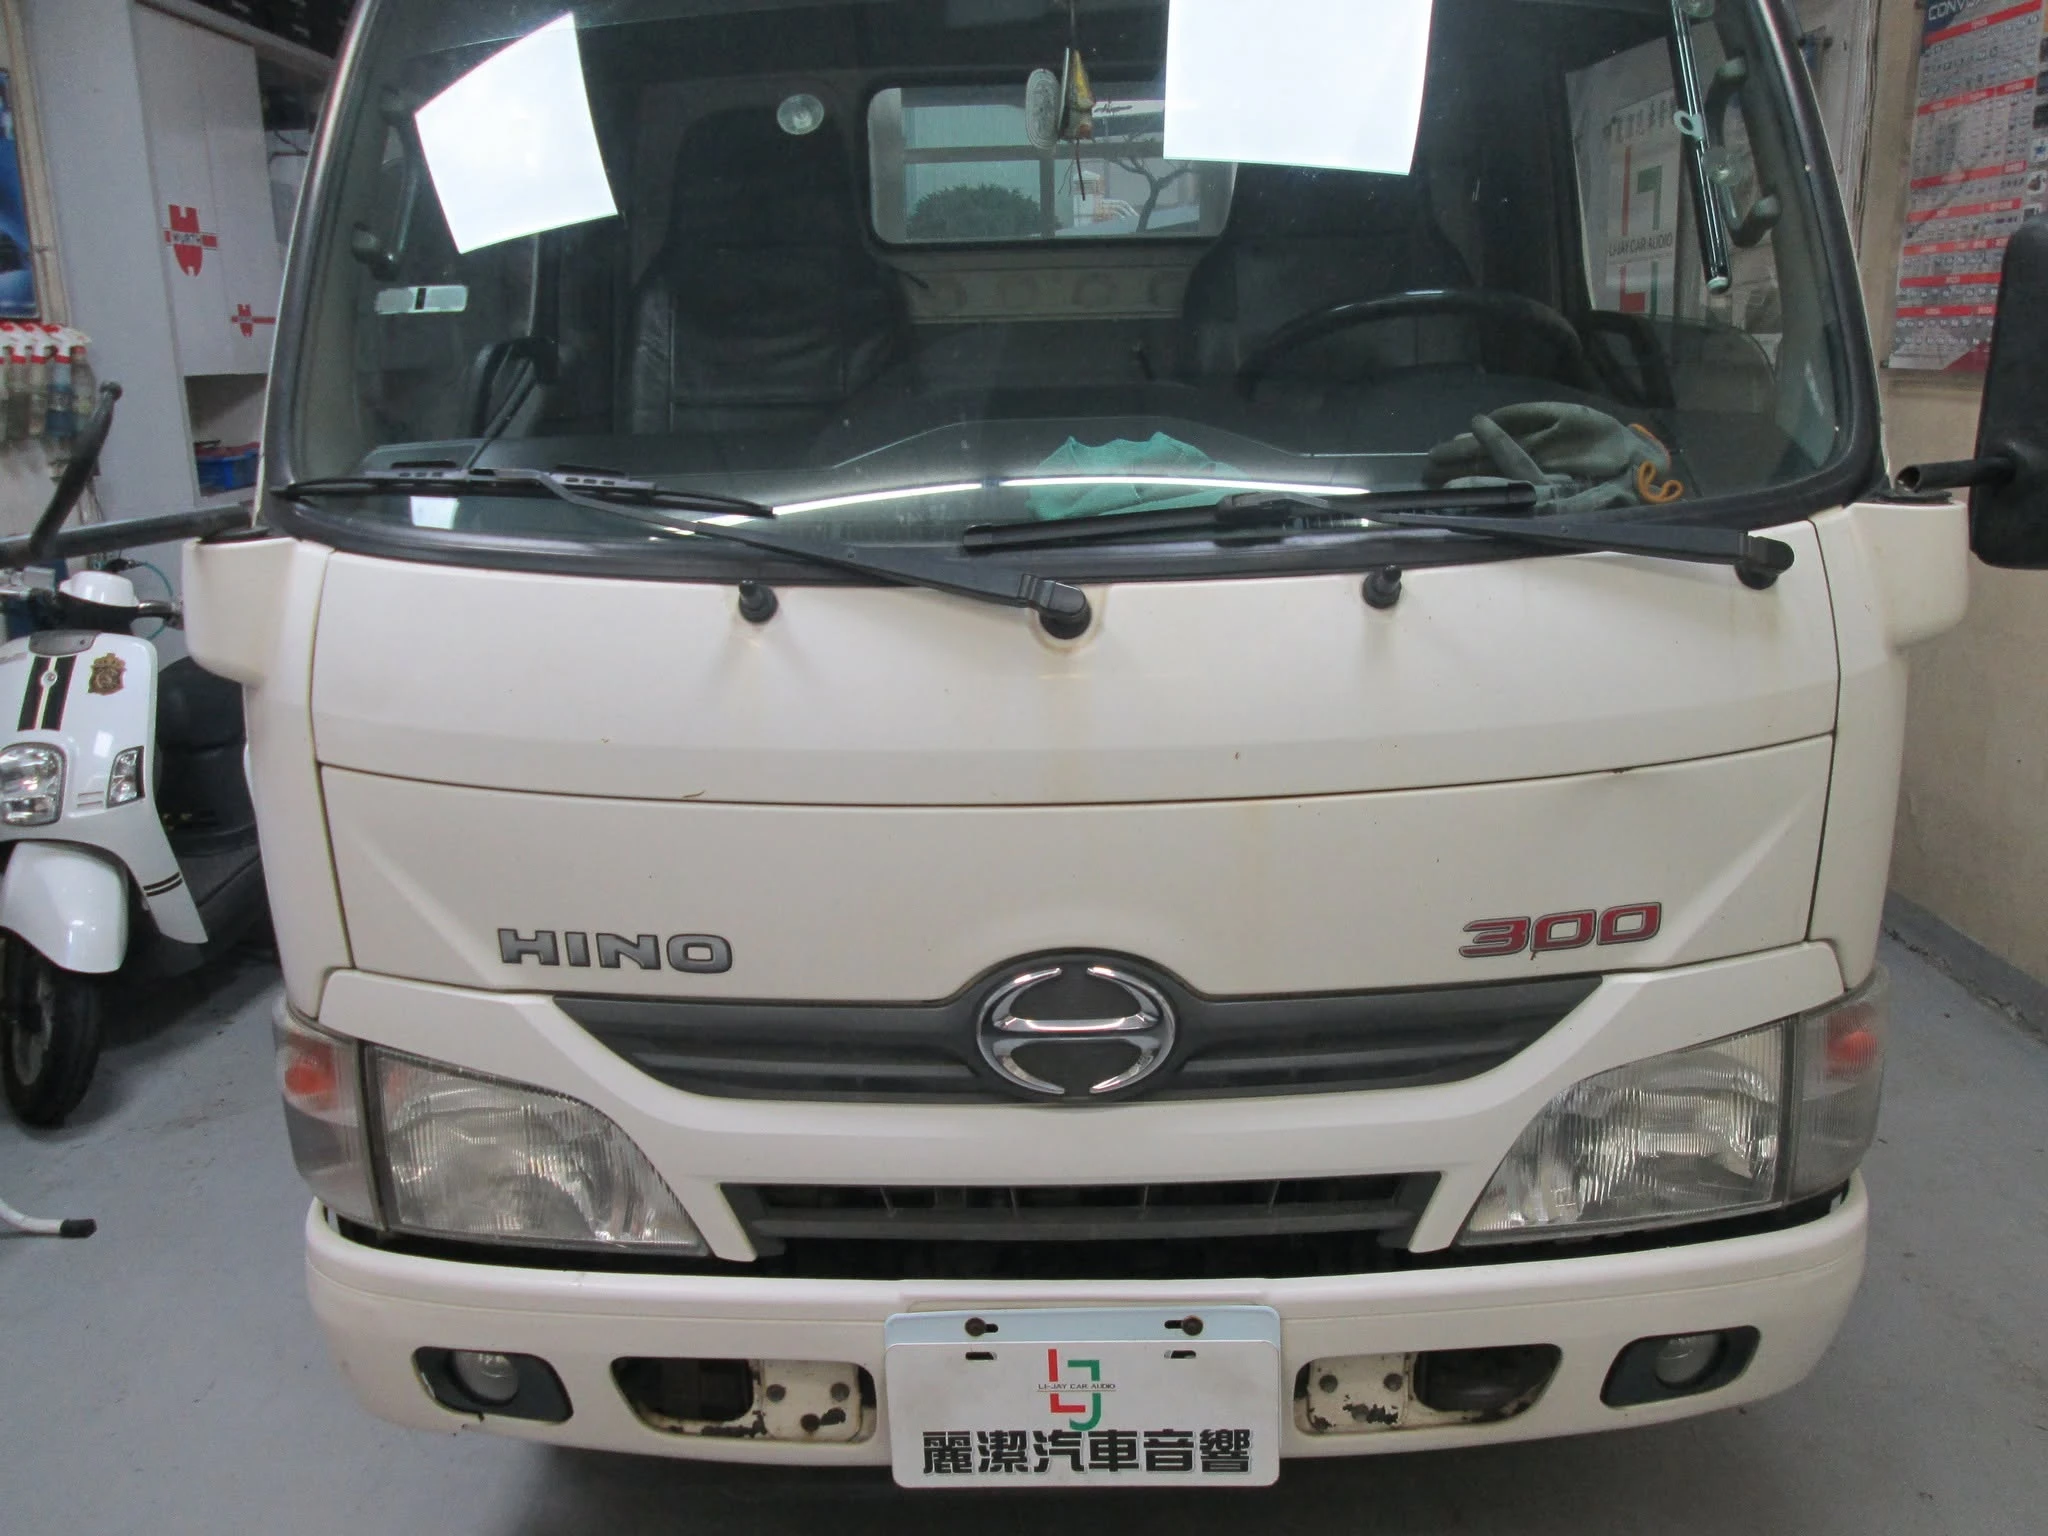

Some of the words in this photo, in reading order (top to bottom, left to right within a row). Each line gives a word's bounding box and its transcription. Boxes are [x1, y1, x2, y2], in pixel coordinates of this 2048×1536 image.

[498, 928, 733, 974] HINO
[1458, 902, 1662, 958] 300
[922, 1428, 1251, 1474] 麗潔汽車音響
